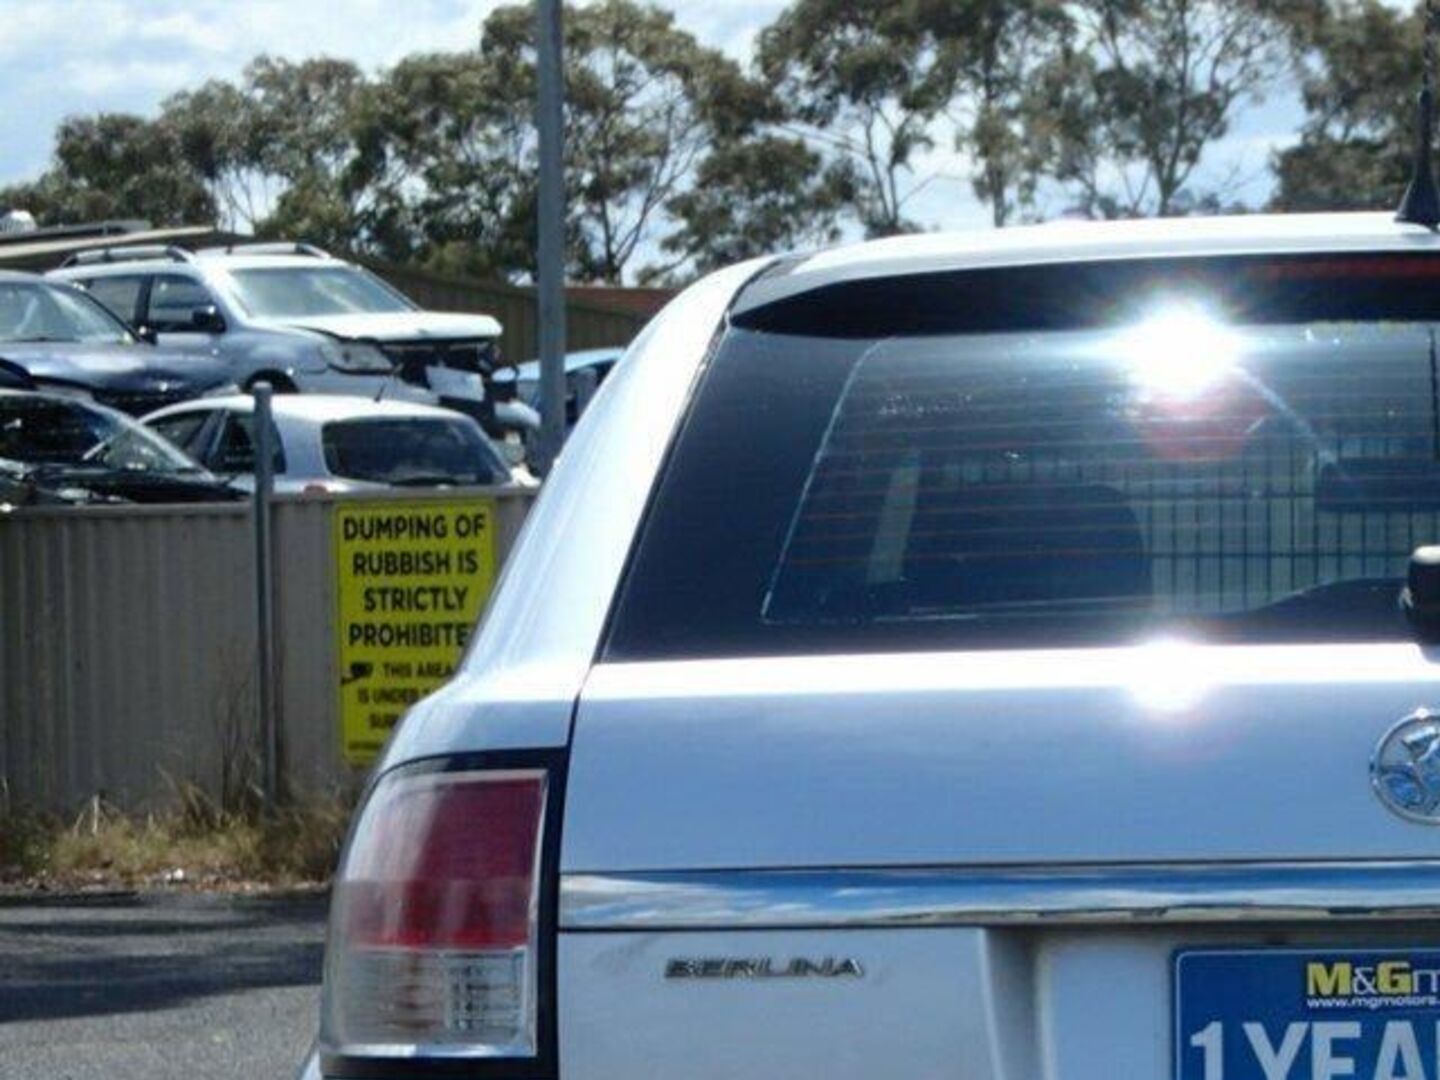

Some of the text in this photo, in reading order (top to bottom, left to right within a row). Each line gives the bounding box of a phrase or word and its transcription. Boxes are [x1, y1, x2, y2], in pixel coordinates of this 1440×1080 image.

[343, 513, 486, 541] DUMPING OF
[353, 550, 479, 576] RUBBISH IS
[364, 586, 469, 613] STRICTLY
[349, 622, 470, 648] PROHIBITE
[664, 955, 865, 979] BERLINA
